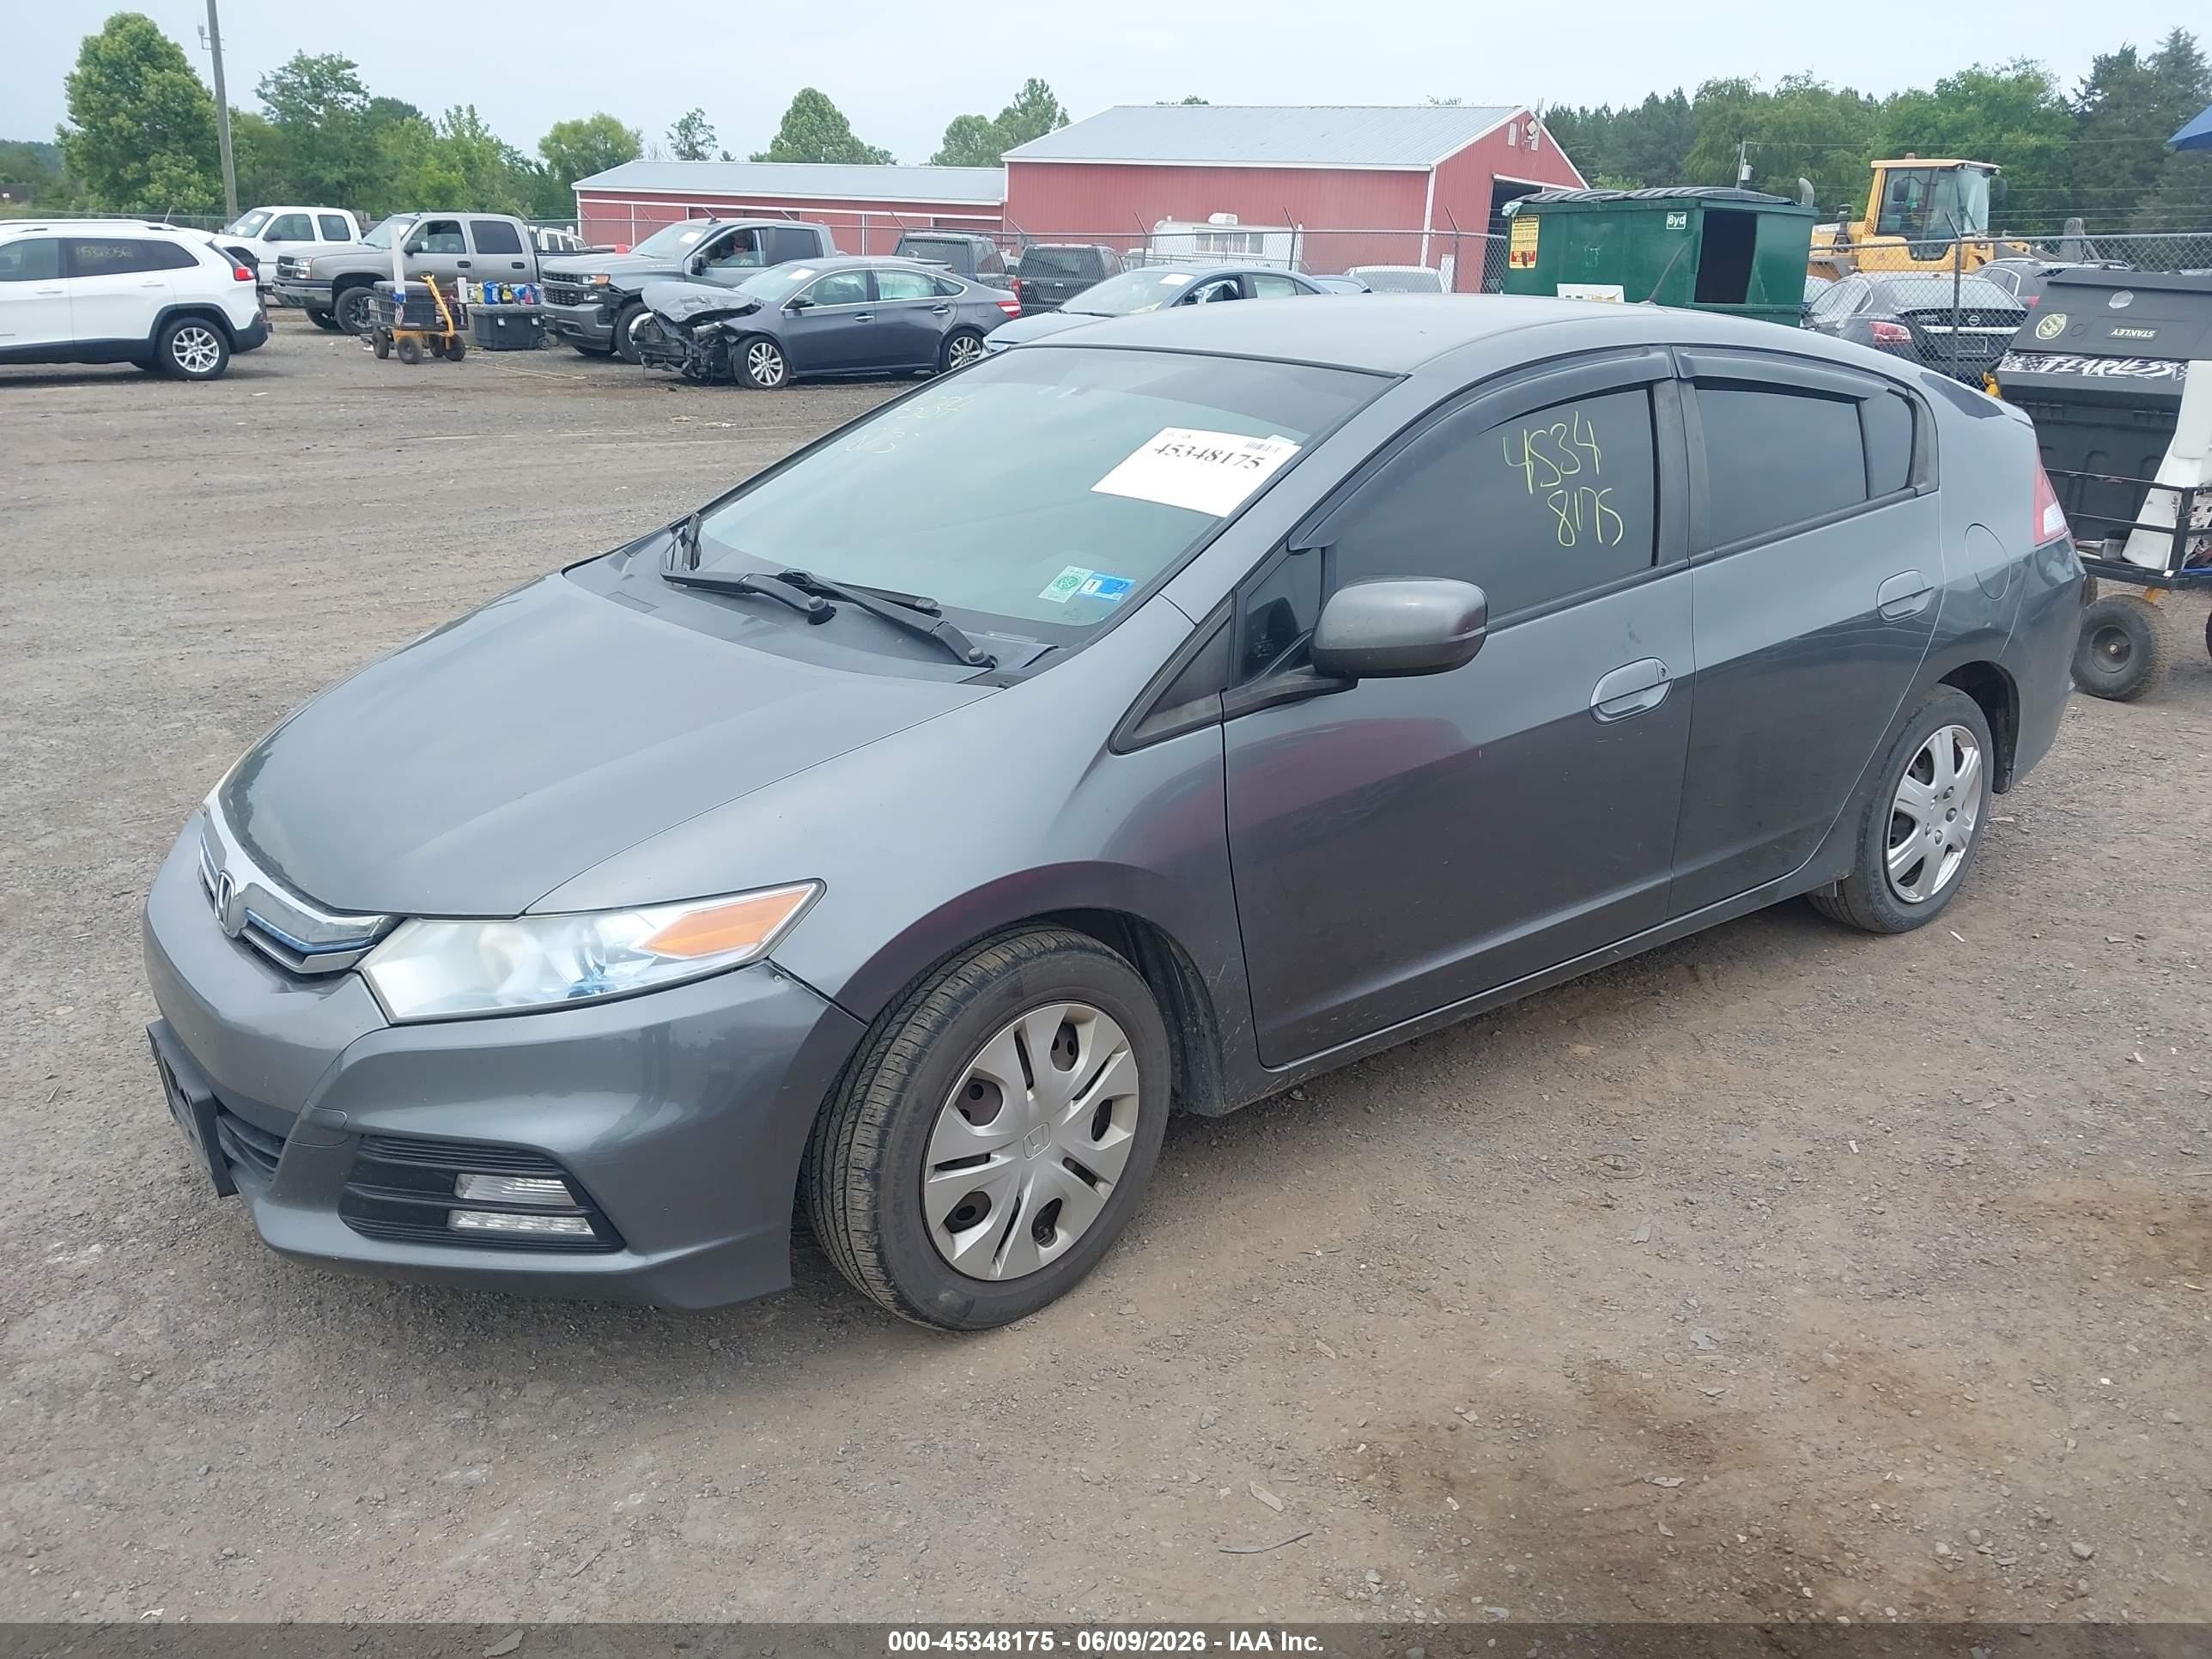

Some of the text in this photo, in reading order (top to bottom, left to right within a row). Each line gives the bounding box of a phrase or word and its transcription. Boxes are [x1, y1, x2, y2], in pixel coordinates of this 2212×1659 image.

[1668, 214, 1686, 228] 8yd
[2111, 327, 2157, 338] STANLEY
[2038, 355, 2185, 379] FEARLESS
[1153, 442, 1266, 470] 45348175
[1502, 410, 1601, 495] 4534
[1547, 486, 1624, 547] 8175
[1113, 581, 1128, 592] 27
